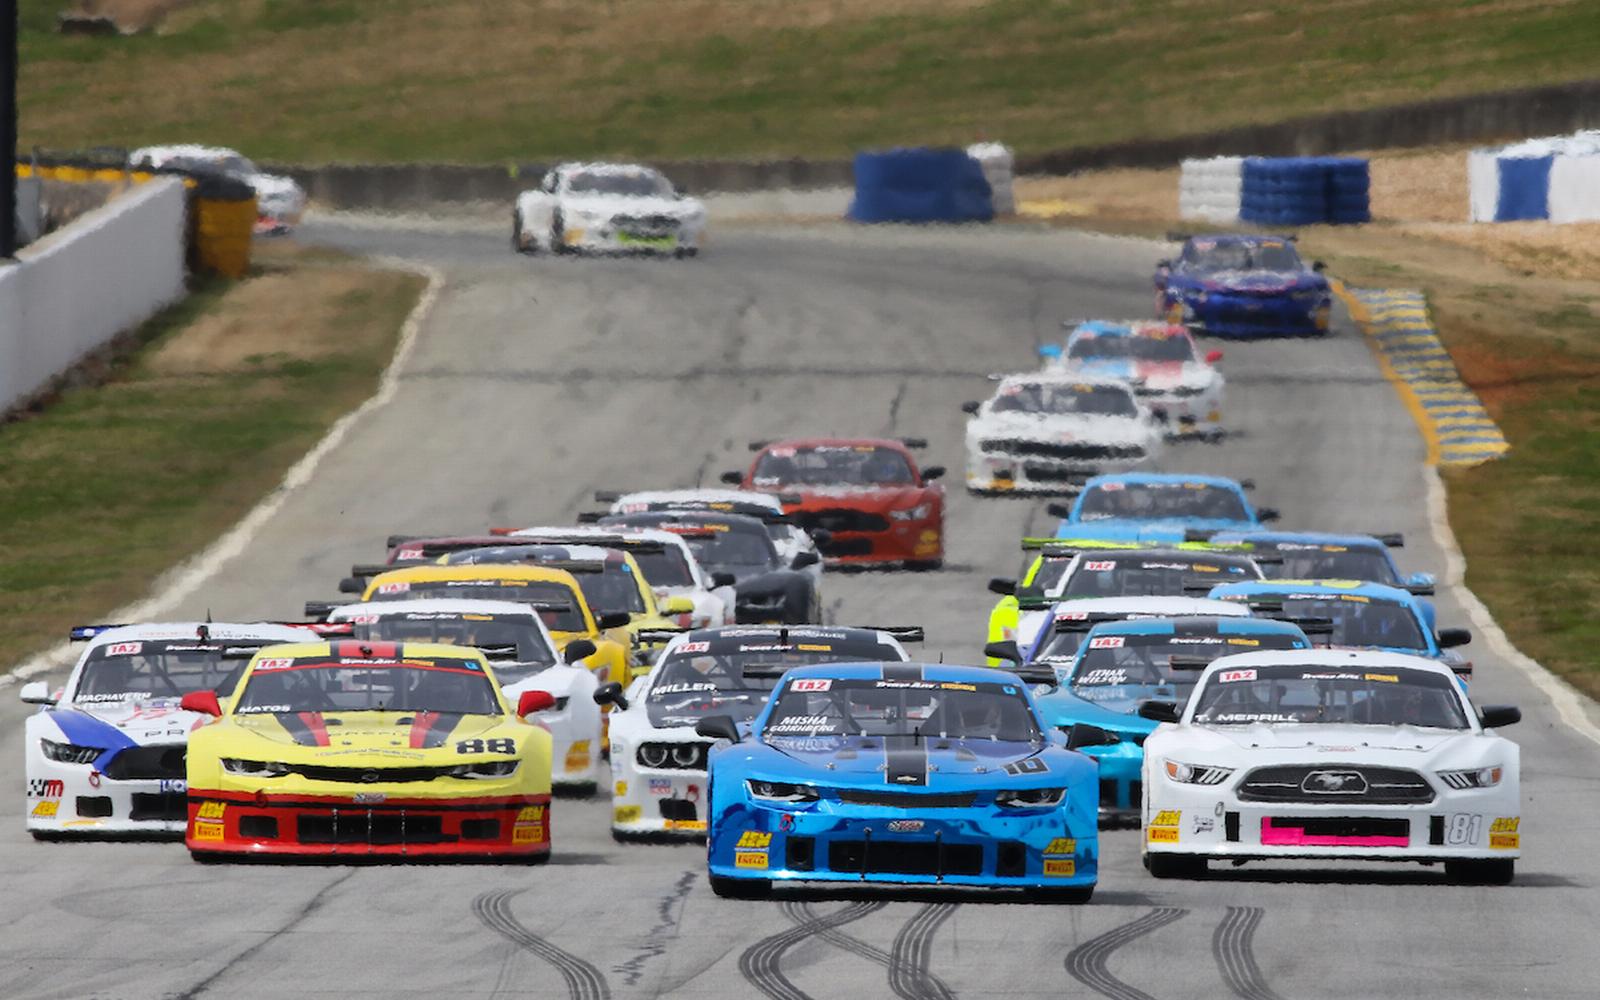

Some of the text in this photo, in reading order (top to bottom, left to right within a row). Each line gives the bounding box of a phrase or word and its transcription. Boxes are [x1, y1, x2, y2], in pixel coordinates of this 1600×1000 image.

[1225, 671, 1253, 681] TA2
[651, 682, 717, 696] MILLER
[797, 681, 827, 690] TA2
[239, 705, 292, 713] MATOS
[780, 716, 828, 725] MISHA
[1217, 713, 1299, 723] MERRILL
[456, 738, 517, 755] 88
[1447, 812, 1482, 845] 81
